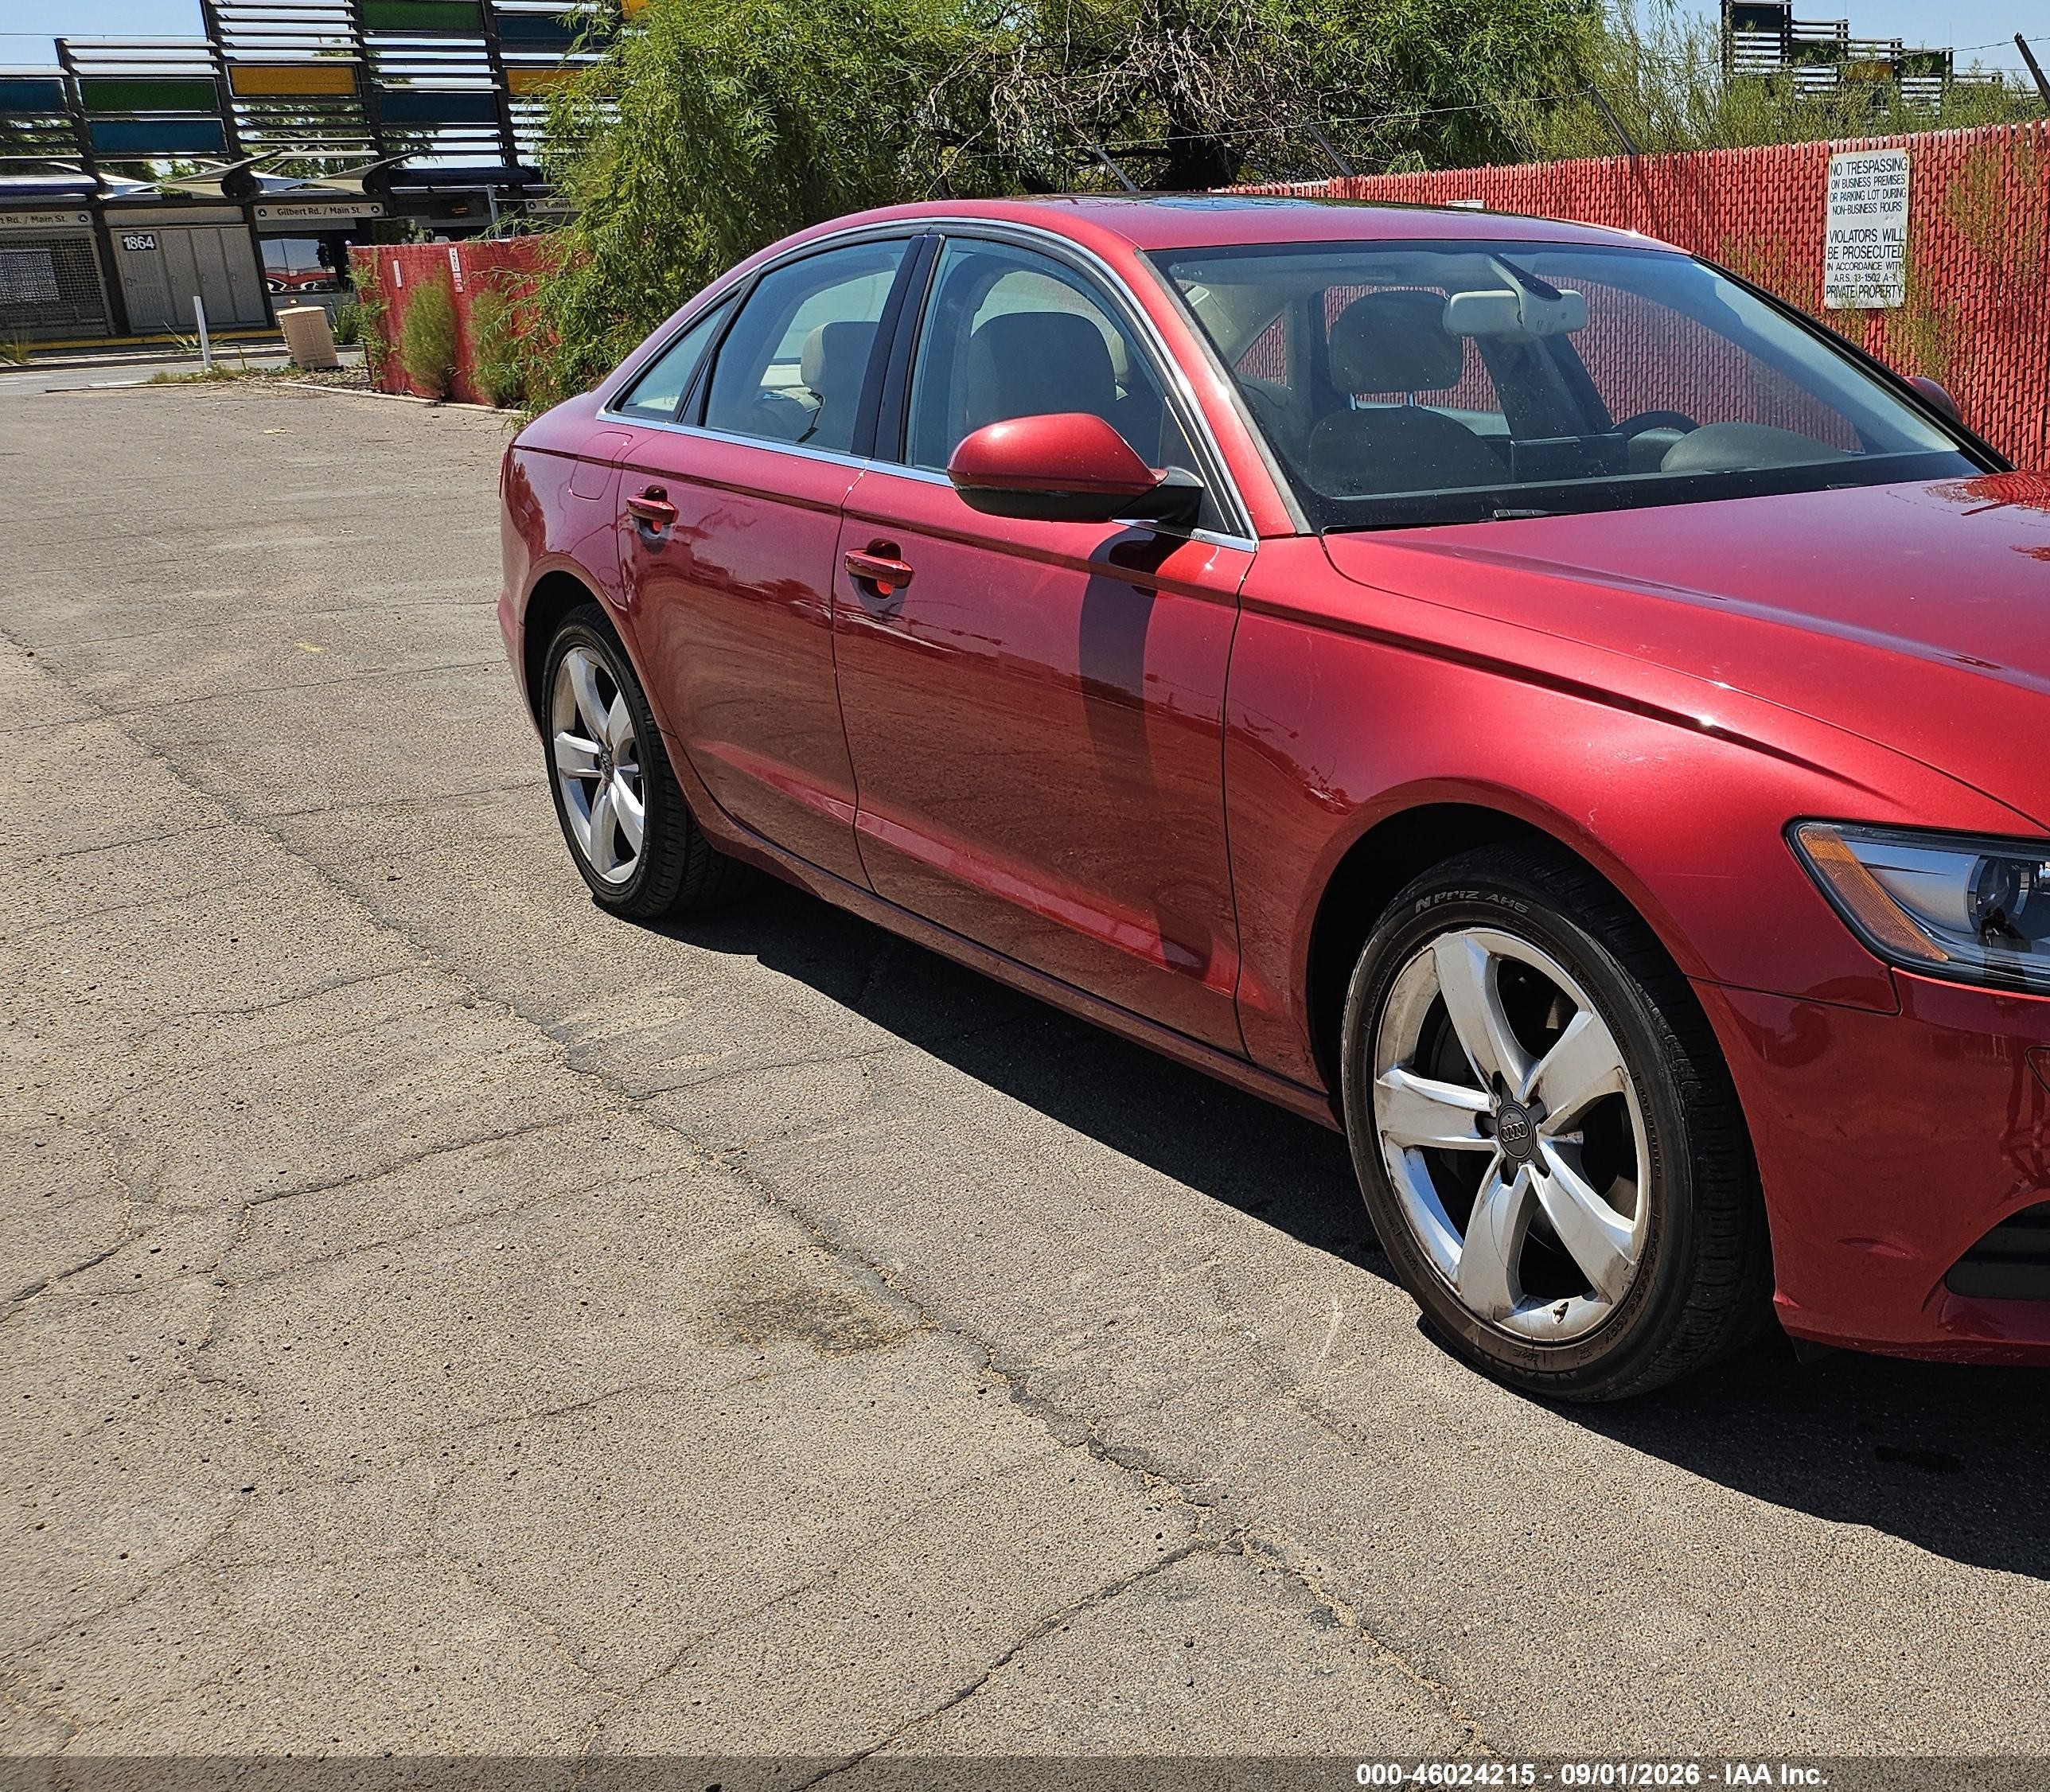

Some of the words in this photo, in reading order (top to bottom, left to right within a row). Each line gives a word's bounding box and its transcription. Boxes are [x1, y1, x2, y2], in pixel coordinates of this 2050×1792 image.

[1830, 162, 1842, 177] NO
[1846, 157, 1908, 176] TRESPASSING
[1830, 178, 1840, 190] ON
[1841, 176, 1872, 189] BUSINESS
[1873, 174, 1906, 187] PREMISES
[1829, 193, 1838, 204] OR
[1840, 190, 1865, 203] PARKING
[1867, 189, 1880, 201] LOT
[1882, 187, 1907, 199] DURING
[1832, 202, 1877, 216] NON-BUSINESS
[1880, 201, 1903, 213] HOURS
[31, 215, 53, 224] Main
[123, 236, 155, 250] 1864
[1829, 228, 1878, 243] VIOLATORS
[1882, 228, 1905, 242] WILL
[1827, 246, 1839, 260] BE
[1842, 243, 1904, 260] PROSECUTED
[1826, 262, 1833, 272] IN
[1835, 261, 1883, 272] ACCORDANCE
[1885, 260, 1904, 271] WITH
[1834, 273, 1851, 282] A.R.S.
[1853, 273, 1880, 282] 13-1502
[1826, 284, 1856, 299] PRIVATE
[1859, 283, 1904, 299] PROPERTY
